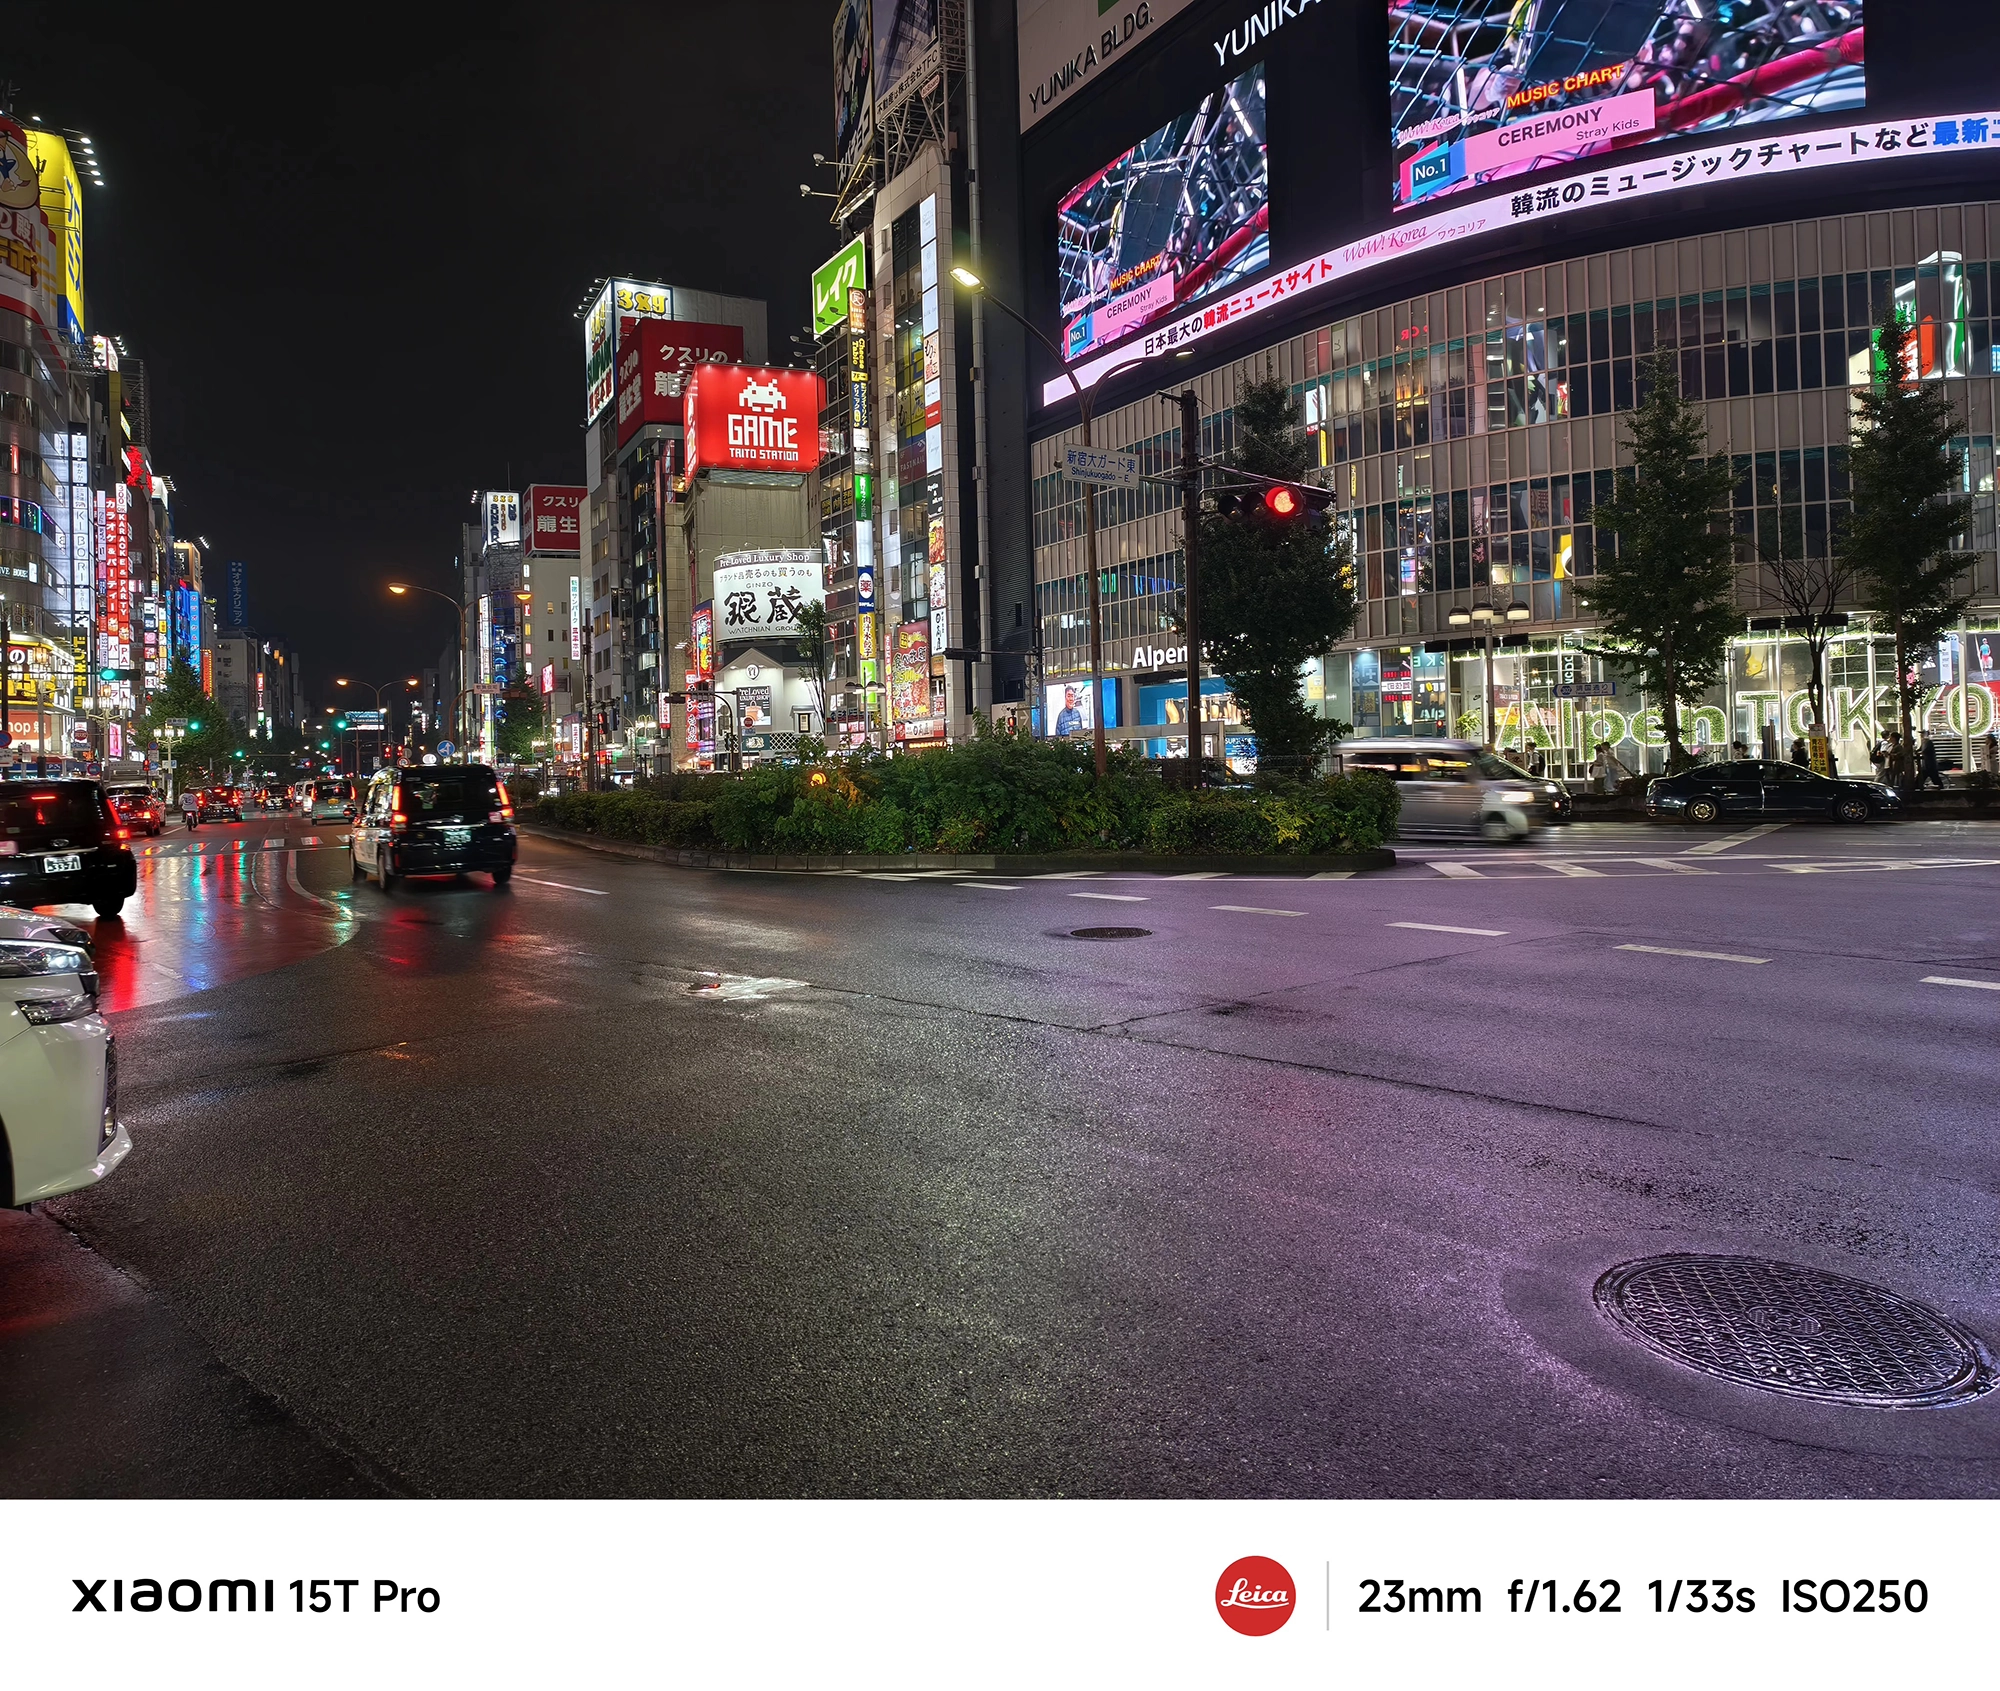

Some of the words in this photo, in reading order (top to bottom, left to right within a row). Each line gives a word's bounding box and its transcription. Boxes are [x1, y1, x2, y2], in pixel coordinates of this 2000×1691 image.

[1028, 44, 1099, 114] YUNIKA
[1100, 1, 1155, 61] BLDG.
[1507, 81, 1560, 109] MUSIC
[1562, 63, 1624, 92] CHART
[1498, 106, 1603, 147] CEREMONY
[1576, 128, 1609, 142] Stray
[1612, 117, 1640, 132] Kids
[1414, 158, 1447, 182] No.1
[1437, 218, 1486, 241] ワウコリア
[1342, 233, 1386, 263] WoW!
[1388, 225, 1428, 249] Korea
[816, 254, 858, 315] レイク
[1110, 271, 1134, 291] MUSIC
[1134, 254, 1161, 277] CHART
[1107, 287, 1152, 319] CEREMONY
[1140, 301, 1155, 314] Stray
[1155, 294, 1168, 306] Kids
[1070, 326, 1086, 342] No.1
[727, 413, 798, 449] GAME
[729, 447, 757, 459] TAITO
[759, 450, 799, 462] STATION
[1066, 449, 1136, 474] 新宿大ガード東
[542, 495, 579, 508] クスリ
[536, 514, 579, 534] 龍生
[118, 513, 128, 567] KARAOKE
[753, 553, 784, 563] Luxury
[787, 551, 810, 563] Shop
[119, 579, 128, 616] PARTY
[745, 581, 774, 589] GINZO
[859, 579, 873, 593] 薬
[728, 625, 771, 635] WATCHNIAN
[1132, 645, 1188, 672] Alpen
[1495, 697, 1729, 763] Alpen
